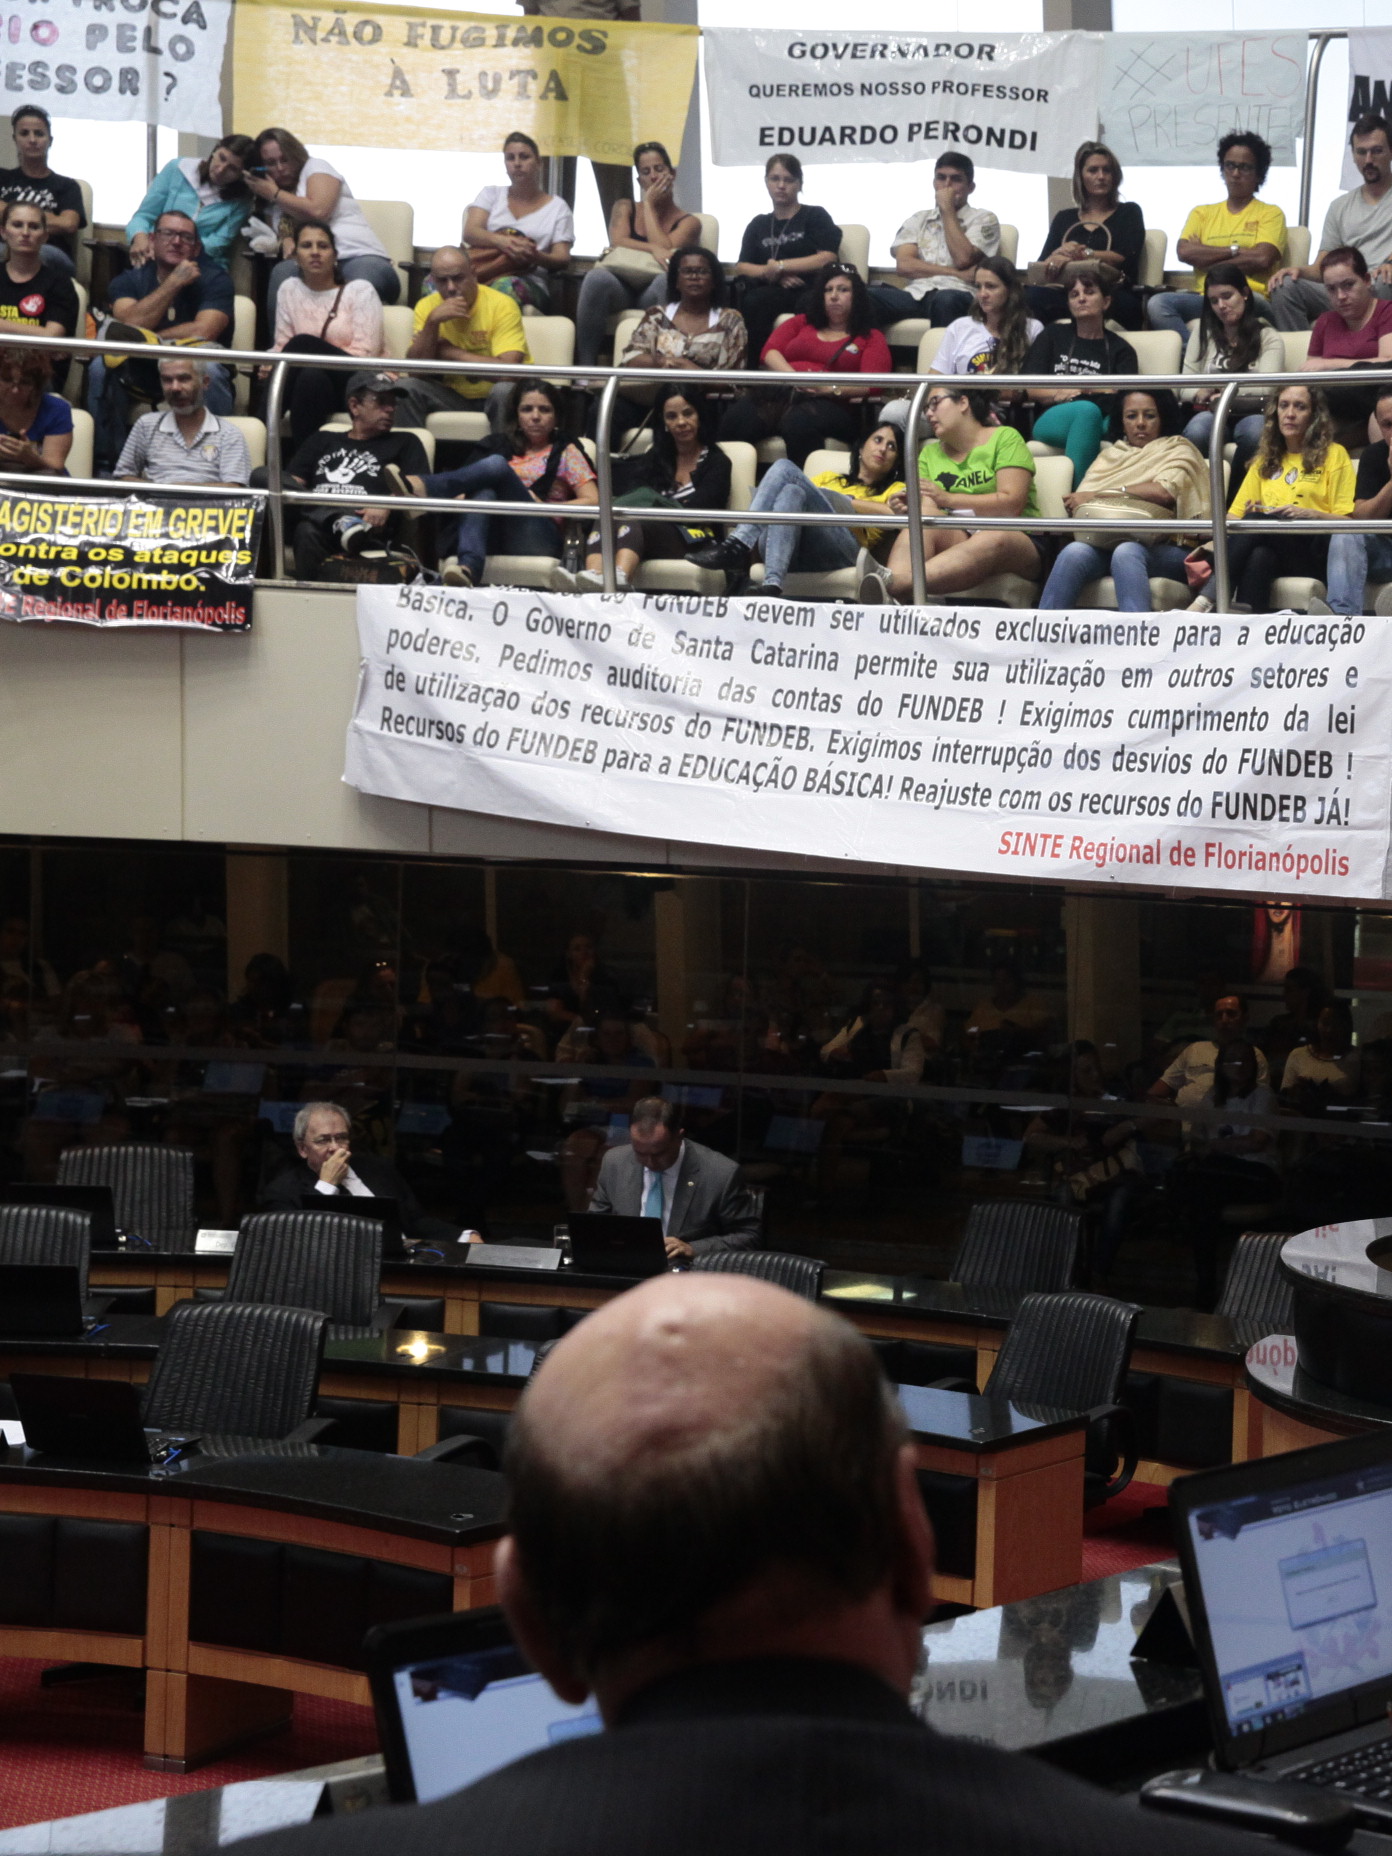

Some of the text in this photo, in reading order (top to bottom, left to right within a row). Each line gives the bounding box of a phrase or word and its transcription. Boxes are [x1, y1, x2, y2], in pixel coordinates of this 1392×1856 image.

[85, 23, 196, 62] PELO
[291, 10, 609, 55] NÃO FUGIMOS
[787, 41, 997, 62] GOVERNADOR
[0, 60, 140, 96] ESSOR
[384, 58, 569, 102] À LUTA
[748, 80, 1049, 104] QUEREMOS NOSSO PROFESSOR
[758, 120, 1038, 152] EDUARDO PERONDI
[955, 470, 994, 488] ANEL
[128, 507, 164, 539] EM
[87, 547, 125, 562] os
[133, 547, 253, 568] ataques
[12, 564, 206, 592] de Colombo.
[21, 595, 101, 622] Regional
[105, 598, 128, 620] de
[133, 599, 246, 627] Florianópolis
[492, 602, 509, 626] O
[526, 607, 612, 642] Governo
[628, 623, 656, 649] de
[671, 630, 734, 661] Santa
[750, 638, 839, 671] Catarina
[854, 651, 938, 680] permite
[952, 660, 990, 682] sua
[1005, 658, 1105, 693] utilização
[1121, 667, 1153, 688] em
[1167, 664, 1235, 688] outros
[1250, 663, 1329, 689] setores
[1345, 666, 1358, 688] e
[829, 608, 865, 632] ser
[879, 608, 981, 640] utilizados
[995, 615, 1161, 648] exclusivamente
[1173, 624, 1221, 652] para
[1237, 625, 1250, 646] a
[1264, 616, 1366, 652] educação
[386, 628, 1356, 737] poderes. Pedimos auditoria das contas do FUNDEB ! Exigimos cumprimento da lei
[384, 664, 406, 692] de
[531, 690, 571, 719] dos
[581, 703, 675, 735] recursos
[684, 712, 712, 740] do
[721, 717, 815, 752] FUNDEB.
[826, 729, 922, 763] Exigimos
[931, 736, 1053, 775] interrupção
[1063, 742, 1101, 771] dos
[1112, 744, 1192, 775] desvios
[1202, 747, 1228, 775] do
[1238, 748, 1333, 779] FUNDEB
[1346, 752, 1354, 780] !
[380, 706, 1351, 826] Recursos do FUNDEB para a EDUCAÇÃO BÁSICA! Reajuste com os recursos do FUNDEB JÁ!
[998, 831, 1350, 880] SINTE Regional de Florianópolis
